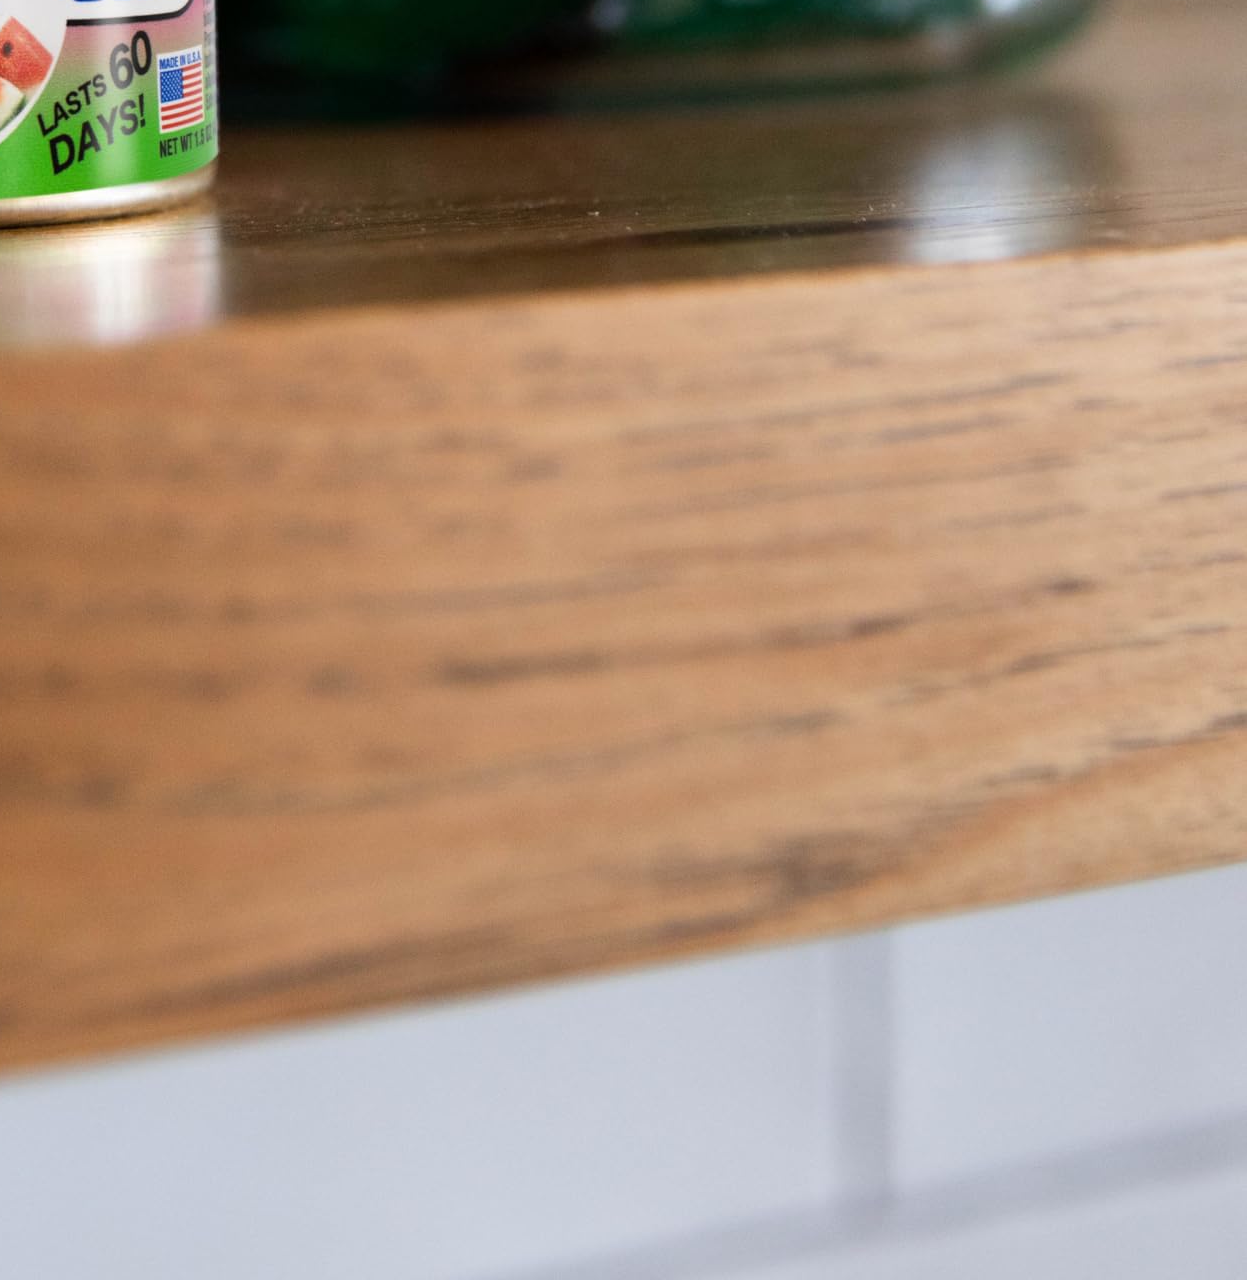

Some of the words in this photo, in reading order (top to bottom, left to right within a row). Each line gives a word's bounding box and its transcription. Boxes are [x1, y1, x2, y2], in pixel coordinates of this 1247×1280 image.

[37, 74, 107, 137] LASTS
[109, 30, 152, 90] 60
[159, 56, 178, 70] MADE
[180, 54, 186, 67] IN
[49, 93, 147, 175] DAYS!
[159, 136, 178, 159] NET
[180, 132, 193, 153] WT
